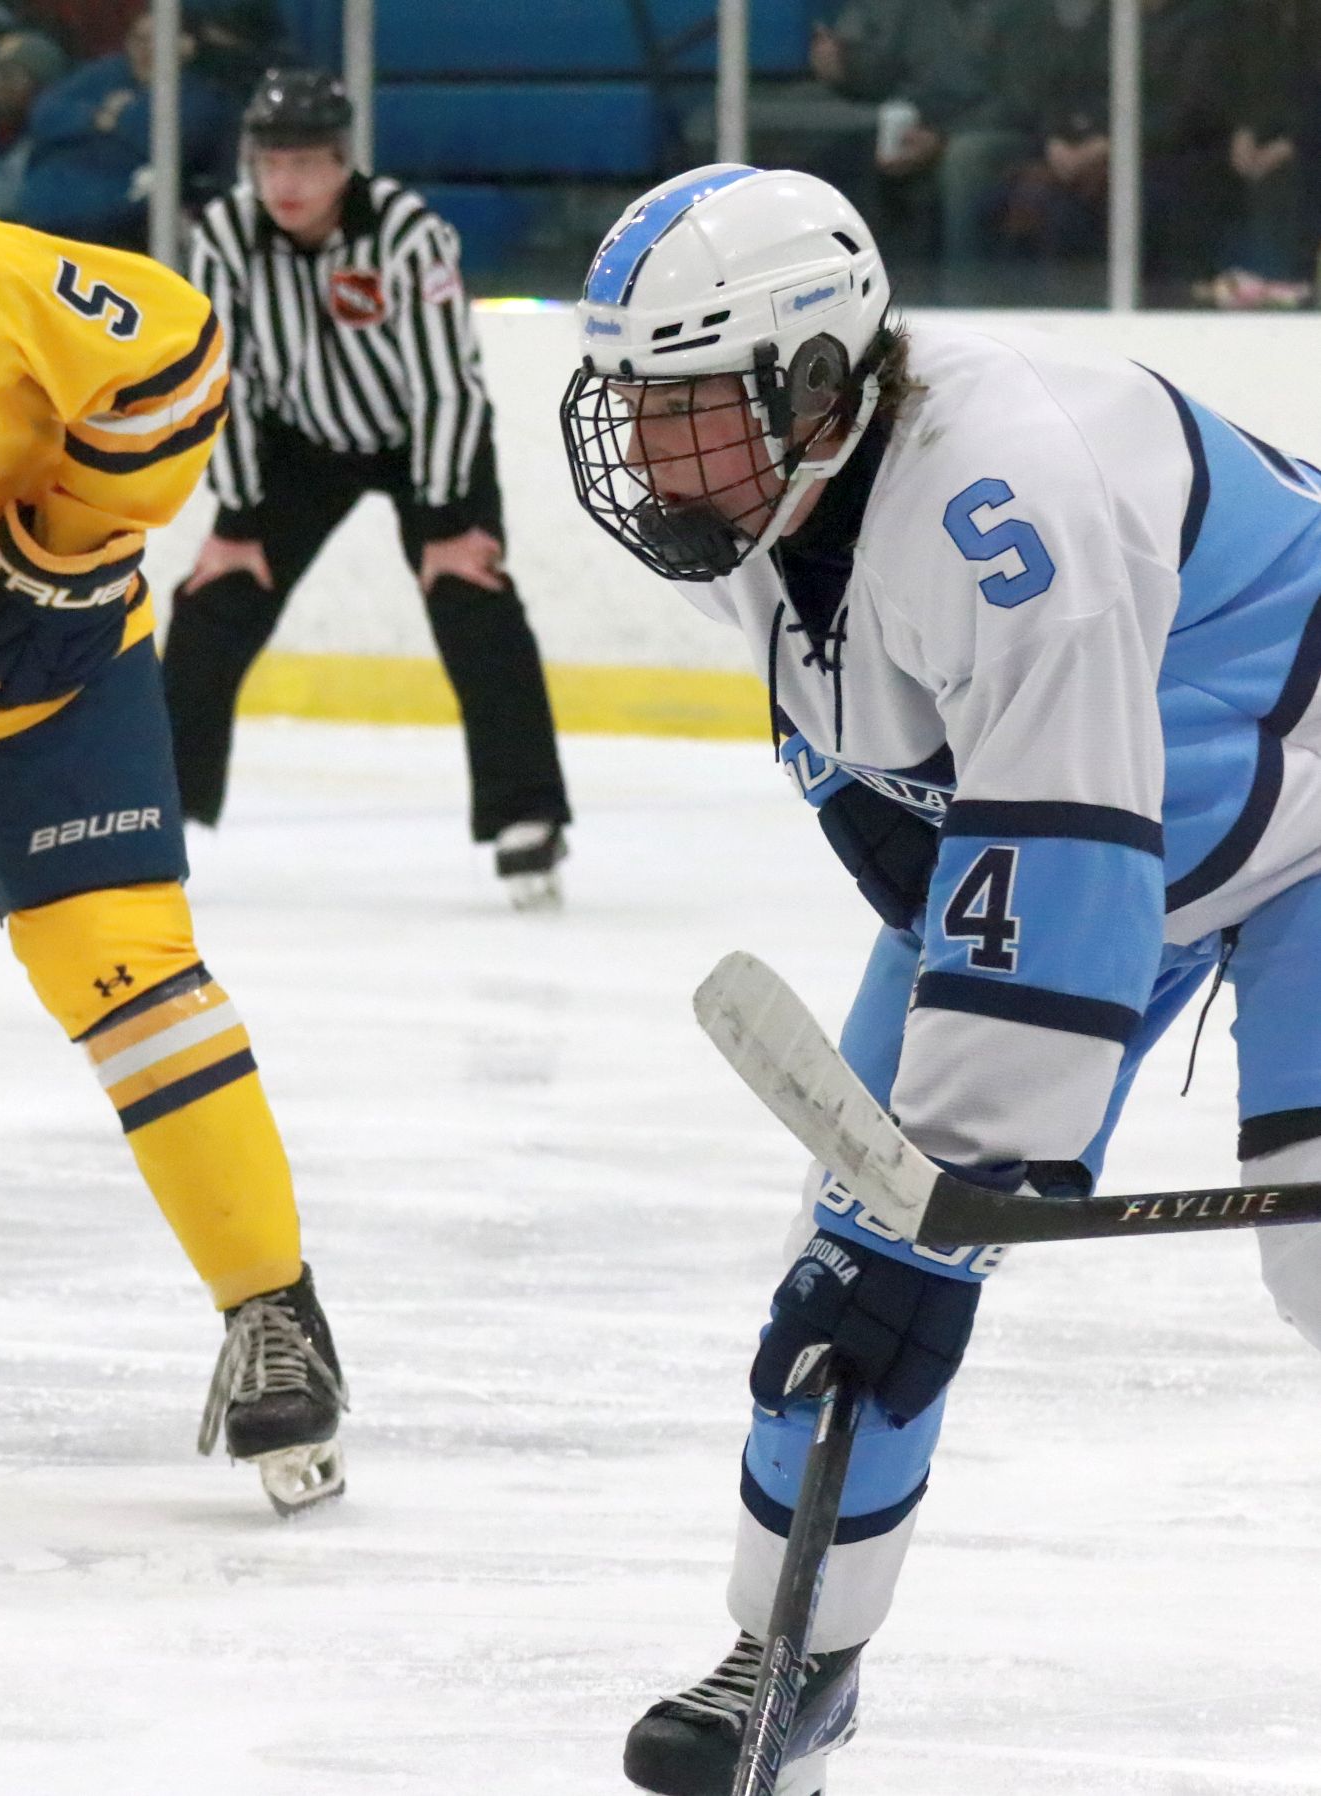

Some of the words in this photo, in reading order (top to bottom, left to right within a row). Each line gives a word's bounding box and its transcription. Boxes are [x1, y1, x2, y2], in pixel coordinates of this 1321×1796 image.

[52, 255, 143, 342] 5
[943, 477, 1056, 609] S
[28, 807, 162, 856] BAUER
[942, 843, 1021, 974] 4
[1118, 1191, 1281, 1222] FLYLITE
